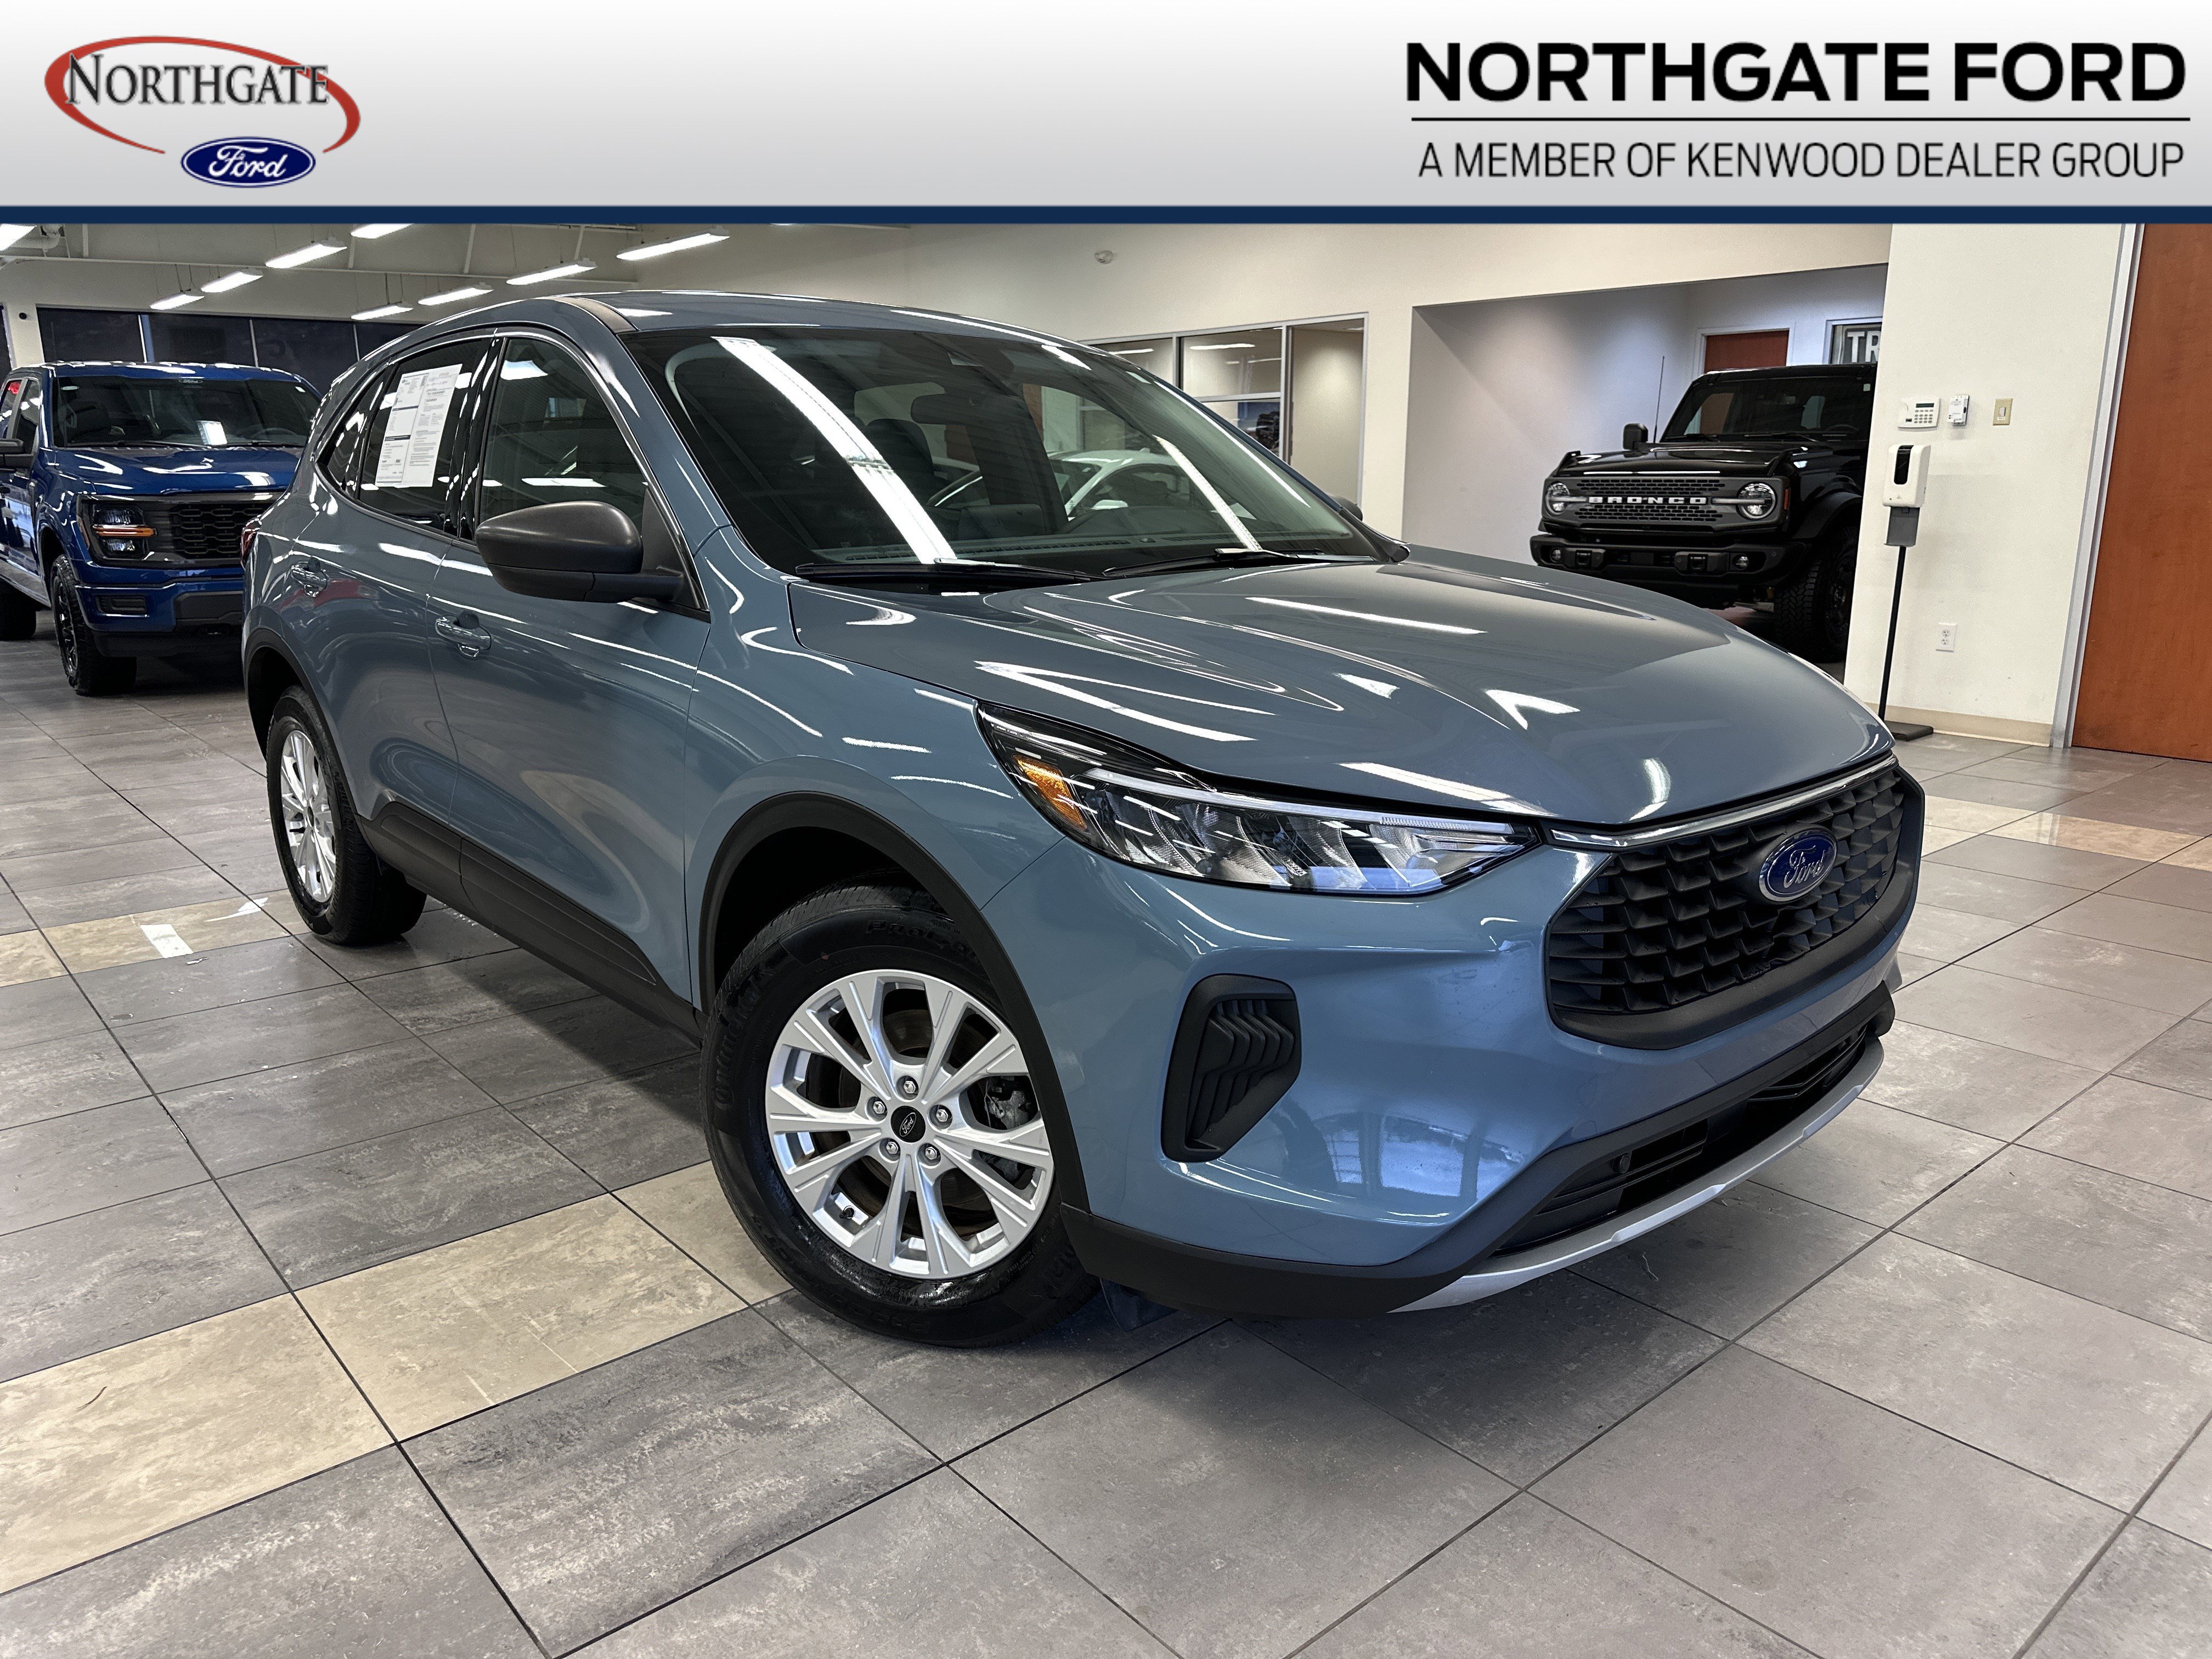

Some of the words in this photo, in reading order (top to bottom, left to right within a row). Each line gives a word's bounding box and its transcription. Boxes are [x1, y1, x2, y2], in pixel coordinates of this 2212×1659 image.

[1588, 496, 1707, 504] BRONCO
[1784, 845, 1826, 888] Ford
[901, 1116, 915, 1134] Ford
